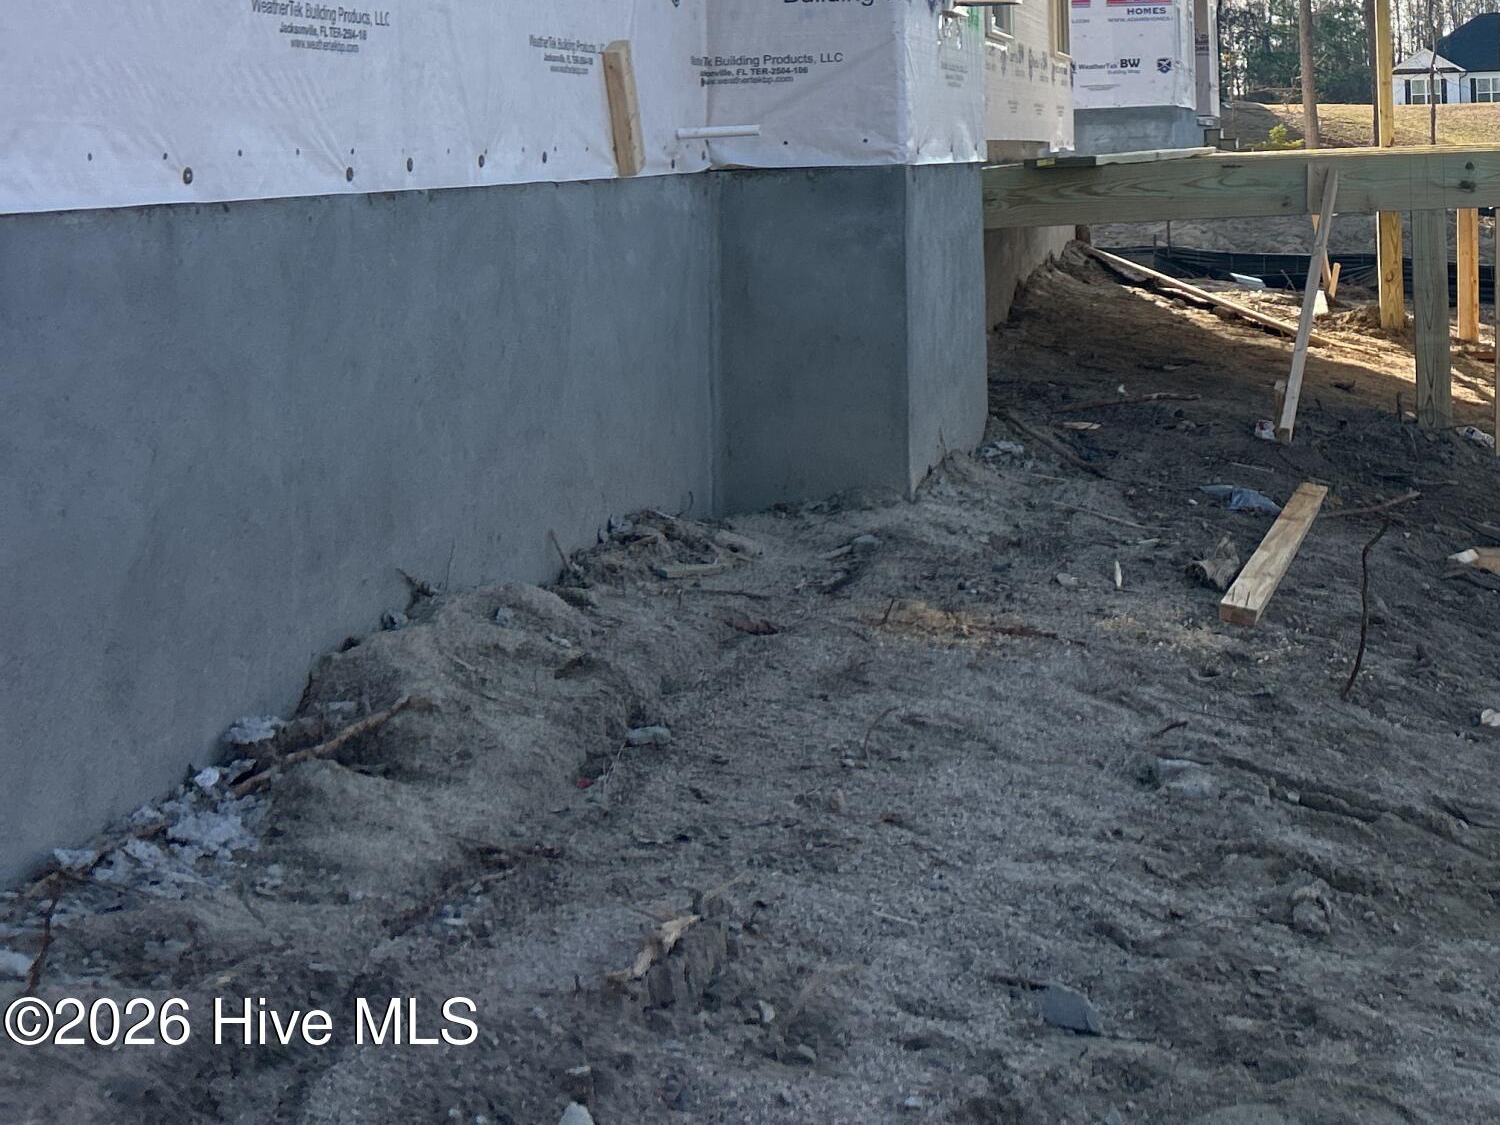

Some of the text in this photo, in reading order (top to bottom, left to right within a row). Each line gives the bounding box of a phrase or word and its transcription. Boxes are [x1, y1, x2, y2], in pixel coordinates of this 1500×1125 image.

[305, 2, 337, 26] Building
[374, 10, 390, 27] LLC
[1127, 7, 1167, 15] HOMES
[714, 55, 760, 68] Building
[763, 54, 817, 65] Products,
[820, 52, 844, 63] LLC
[1120, 58, 1140, 68] BW
[736, 68, 747, 76] FL
